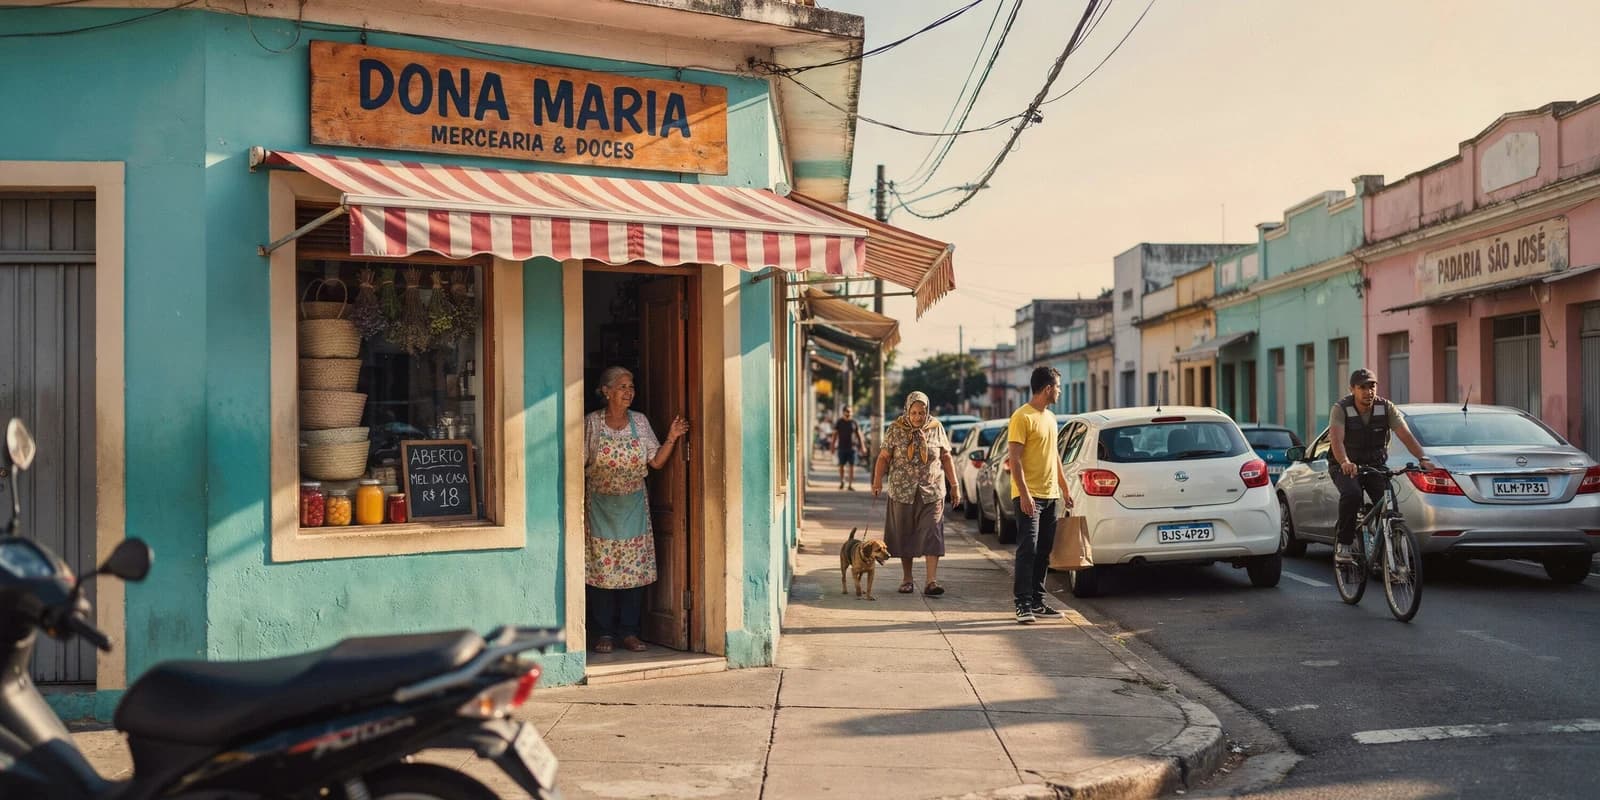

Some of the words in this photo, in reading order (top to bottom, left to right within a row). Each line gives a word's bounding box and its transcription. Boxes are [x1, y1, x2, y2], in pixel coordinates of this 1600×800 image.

[359, 58, 509, 121] DONA
[533, 77, 692, 138] MARIA
[431, 125, 544, 151] MERCEARIA
[553, 136, 566, 154] &
[576, 137, 634, 160] DOCES
[1437, 248, 1482, 285] PADARIA
[1488, 237, 1510, 273] SÃO
[1513, 225, 1546, 267] JOSÉ
[410, 448, 463, 465] ABERTO
[410, 472, 429, 485] MEL
[432, 473, 444, 485] DA
[445, 472, 469, 484] CASA
[422, 488, 436, 502] R$
[440, 487, 460, 508] 18
